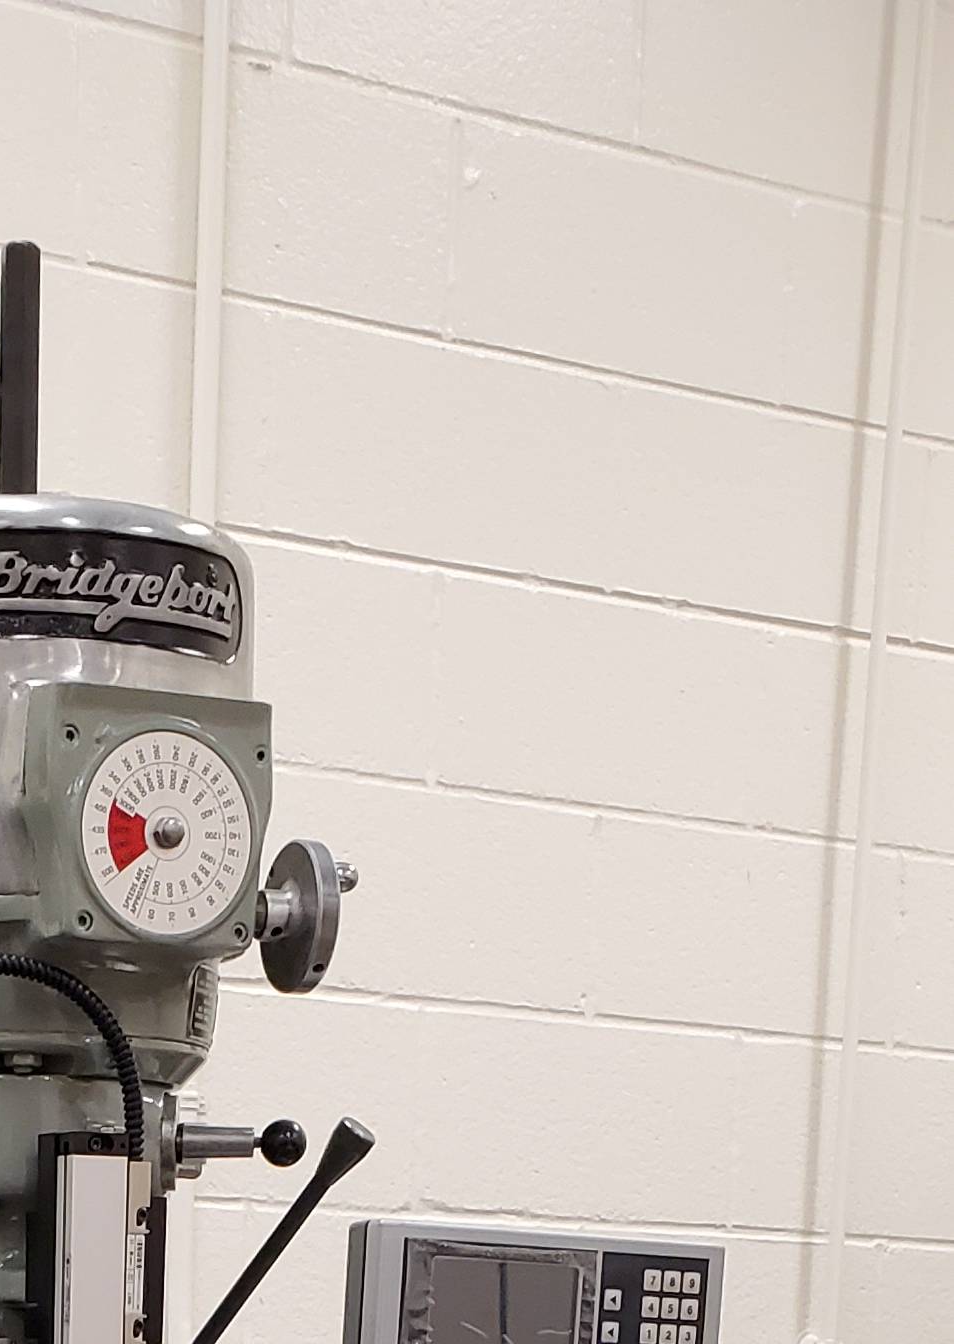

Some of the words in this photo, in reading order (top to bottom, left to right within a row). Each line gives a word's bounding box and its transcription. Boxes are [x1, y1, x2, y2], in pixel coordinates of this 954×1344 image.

[188, 752, 198, 768] 200
[156, 769, 164, 789] 2200
[217, 785, 229, 797] 170
[200, 808, 217, 820] 1400
[227, 815, 239, 824] 150
[205, 832, 221, 840] 1200
[228, 832, 241, 840] 140
[200, 851, 216, 866] 1000
[222, 864, 235, 876] 120
[122, 881, 138, 910] SPEEDS
[135, 866, 144, 881] ARE
[168, 912, 175, 922] 70
[650, 1275, 656, 1286] 7
[670, 1277, 676, 1287] 8
[689, 1278, 695, 1289] 9
[648, 1302, 654, 1313] 4
[667, 1303, 674, 1314] 5
[687, 1305, 693, 1315] 6
[646, 1329, 651, 1340] 1
[665, 1330, 672, 1341] 2
[685, 1331, 691, 1342] 3
